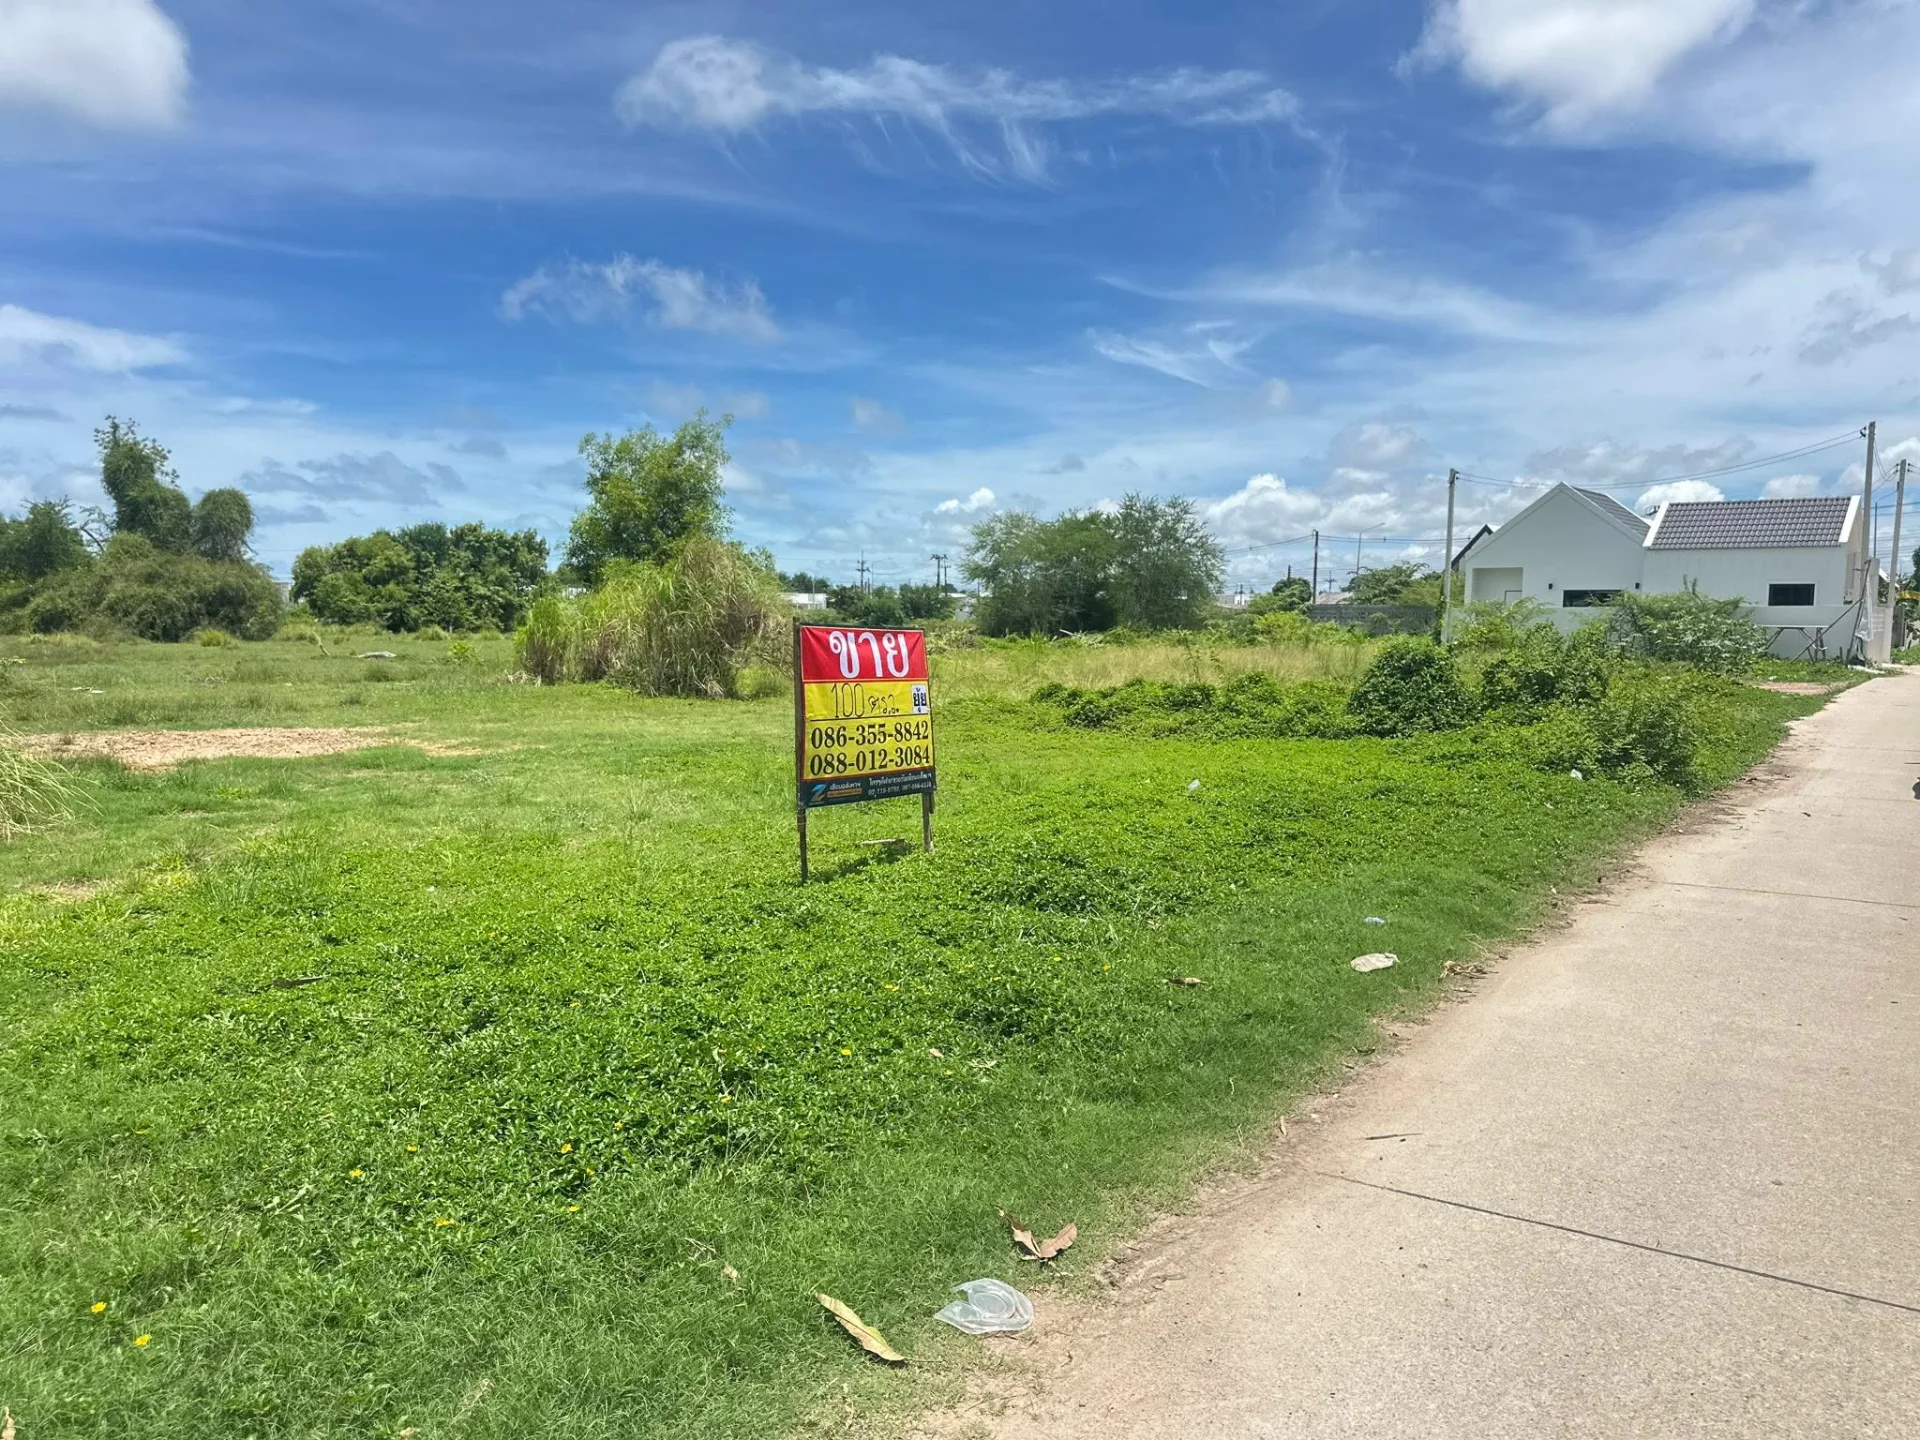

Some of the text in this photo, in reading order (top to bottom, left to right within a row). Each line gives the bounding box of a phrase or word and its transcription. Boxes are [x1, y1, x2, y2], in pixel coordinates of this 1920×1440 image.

[829, 630, 910, 679] ขาย
[831, 682, 865, 718] 100
[810, 720, 929, 749] 086-355-8842
[809, 744, 930, 776] 088-012-3084
